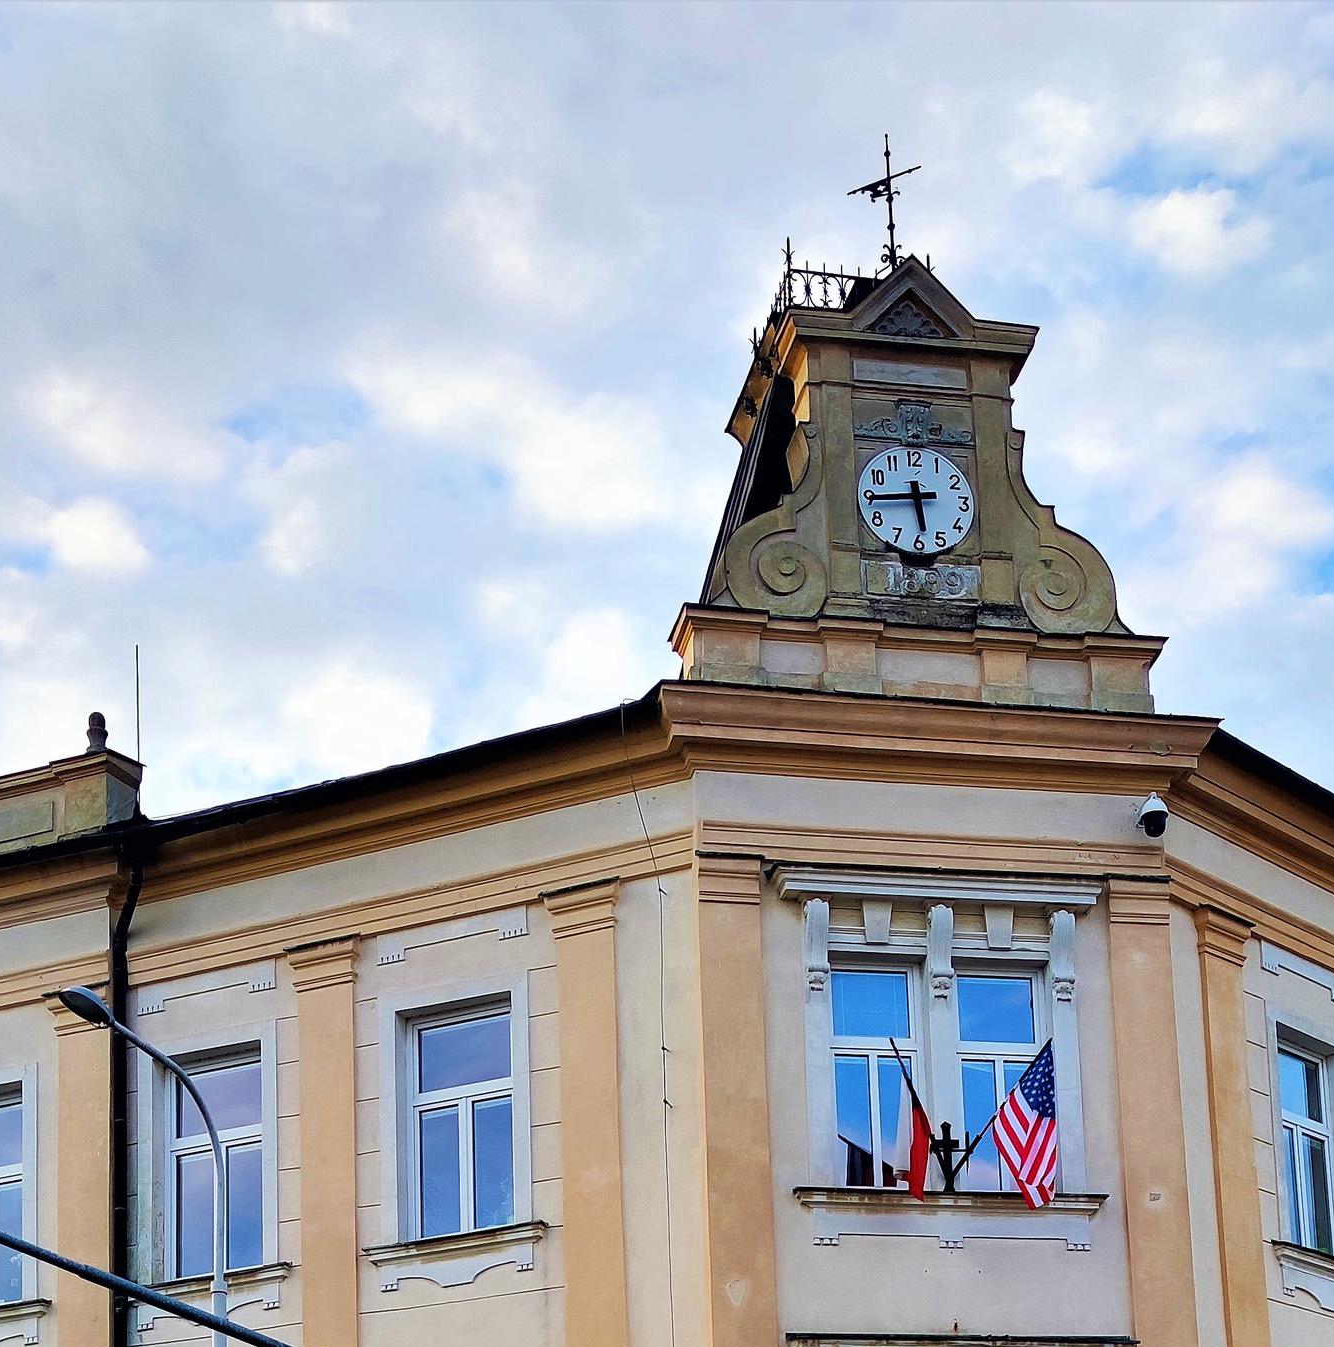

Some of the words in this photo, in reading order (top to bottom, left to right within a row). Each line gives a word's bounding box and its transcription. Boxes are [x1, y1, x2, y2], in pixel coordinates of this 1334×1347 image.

[886, 455, 899, 471] 11
[906, 451, 923, 467] 12
[934, 457, 939, 474] 1
[871, 469, 885, 485] 10
[949, 474, 961, 491] 2
[958, 496, 970, 512] 3
[871, 511, 884, 527] 8
[952, 517, 964, 534] 4
[892, 527, 903, 544] 7
[913, 534, 925, 551] 6
[934, 531, 947, 548] 5
[885, 567, 963, 595] 1899
